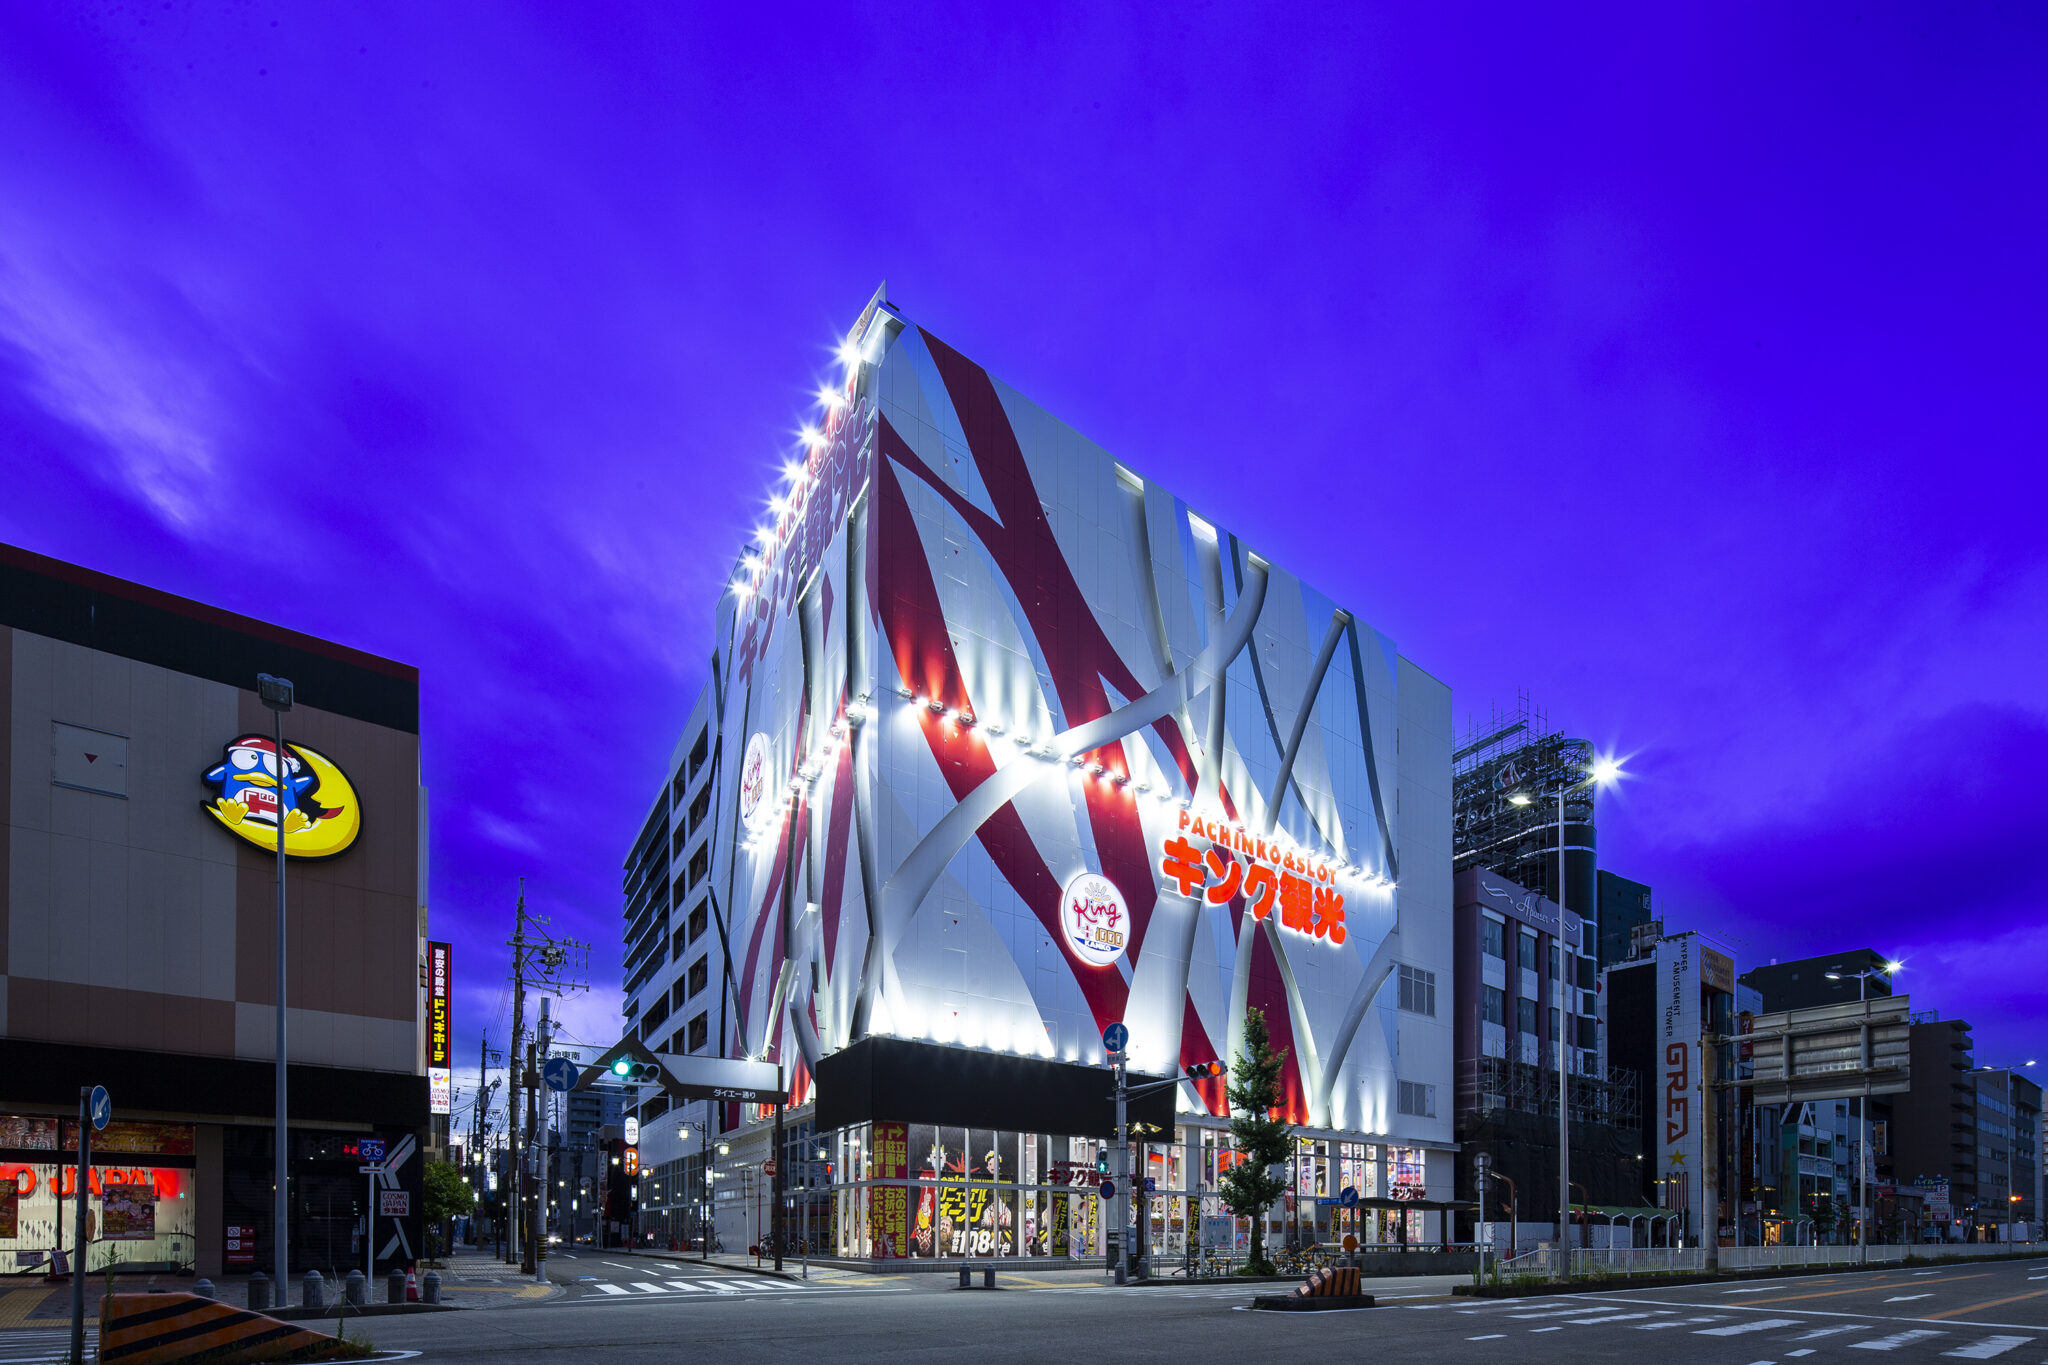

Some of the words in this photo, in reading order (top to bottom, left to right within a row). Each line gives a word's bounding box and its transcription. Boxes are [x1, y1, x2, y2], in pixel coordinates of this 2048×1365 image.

[738, 396, 870, 688] キング観光
[1178, 808, 1338, 886] PACHINKO&SLOT
[1162, 835, 1347, 945] キング観光
[1073, 897, 1122, 928] King
[1084, 939, 1112, 952] KANKO
[1680, 941, 1688, 972] HYPER
[1672, 961, 1681, 1017] AMUSEMENT
[1665, 1006, 1673, 1038] TOWER
[713, 1088, 756, 1099] ダイエー通り
[1666, 1042, 1688, 1145] GREA
[895, 1140, 906, 1166] 立体
[383, 1192, 408, 1200] COSMO
[895, 1187, 906, 1256] 次の交差点を
